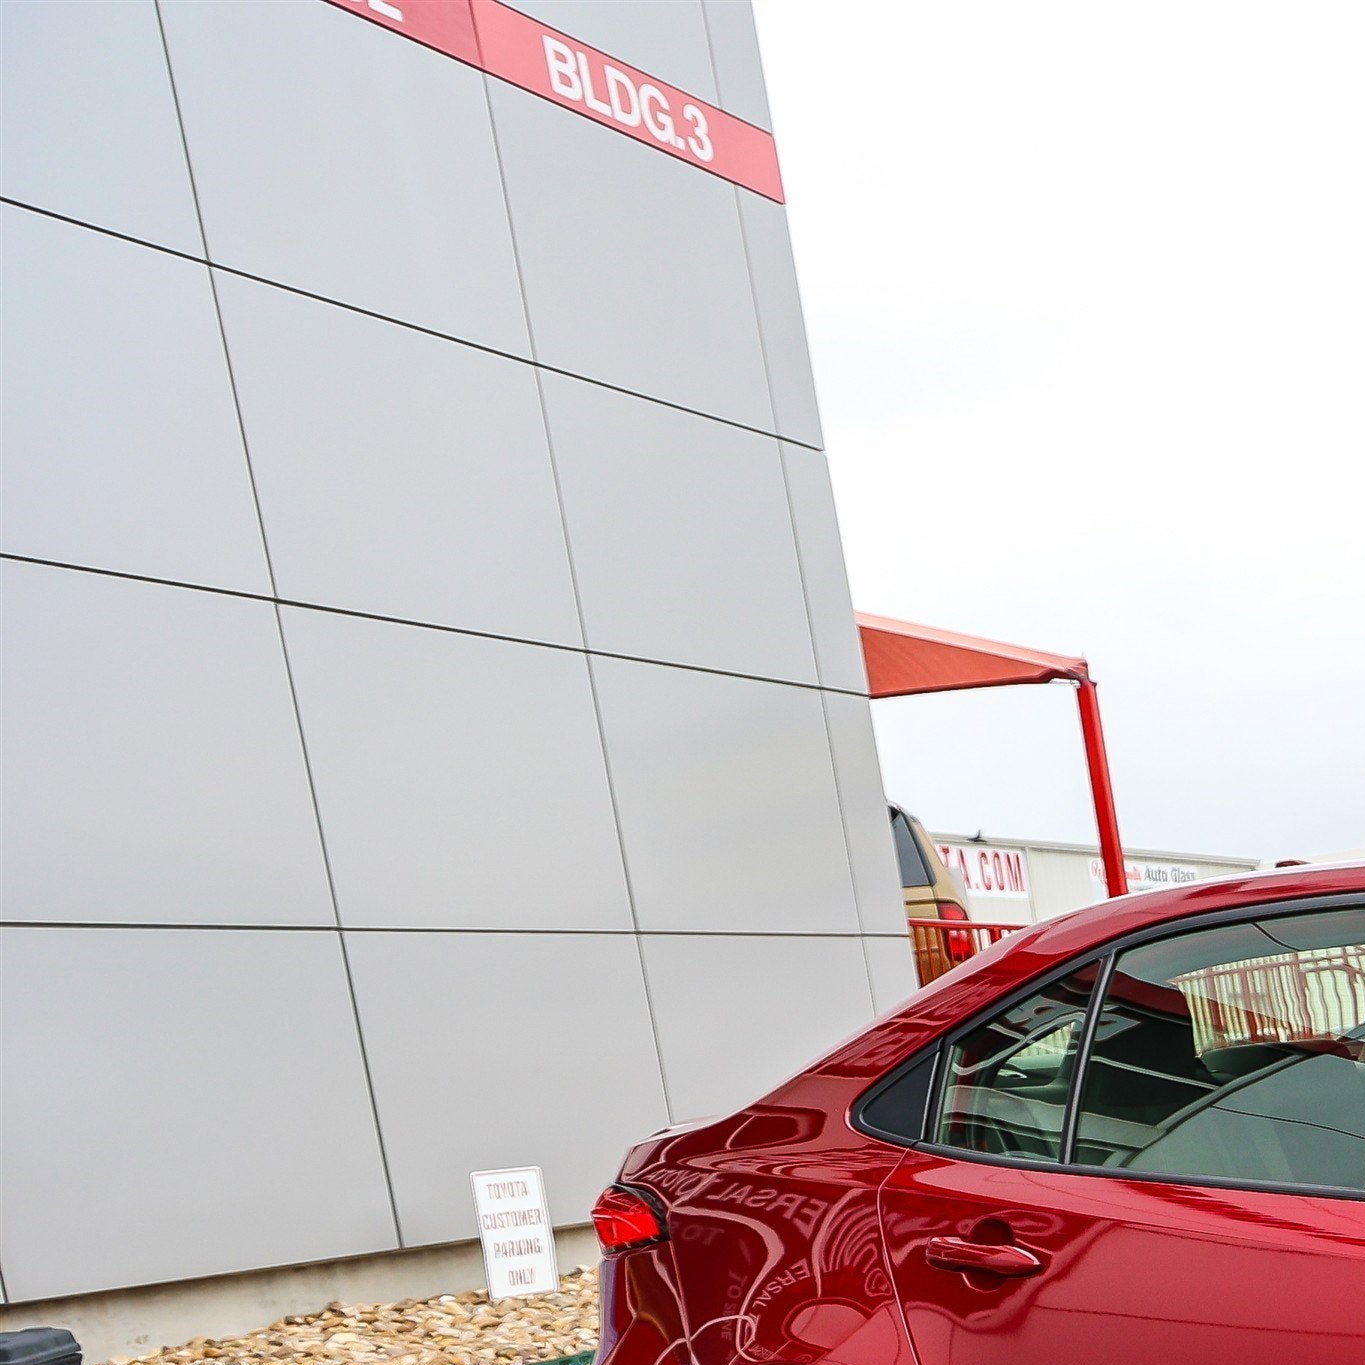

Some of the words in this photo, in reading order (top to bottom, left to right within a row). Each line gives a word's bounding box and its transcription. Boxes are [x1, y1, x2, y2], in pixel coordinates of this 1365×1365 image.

[1145, 866, 1168, 882] Auto
[486, 1181, 528, 1199] TOYOTA
[482, 1208, 542, 1230] CUSTOMER
[494, 1239, 542, 1258] PARKING
[508, 1268, 536, 1286] ONLY
